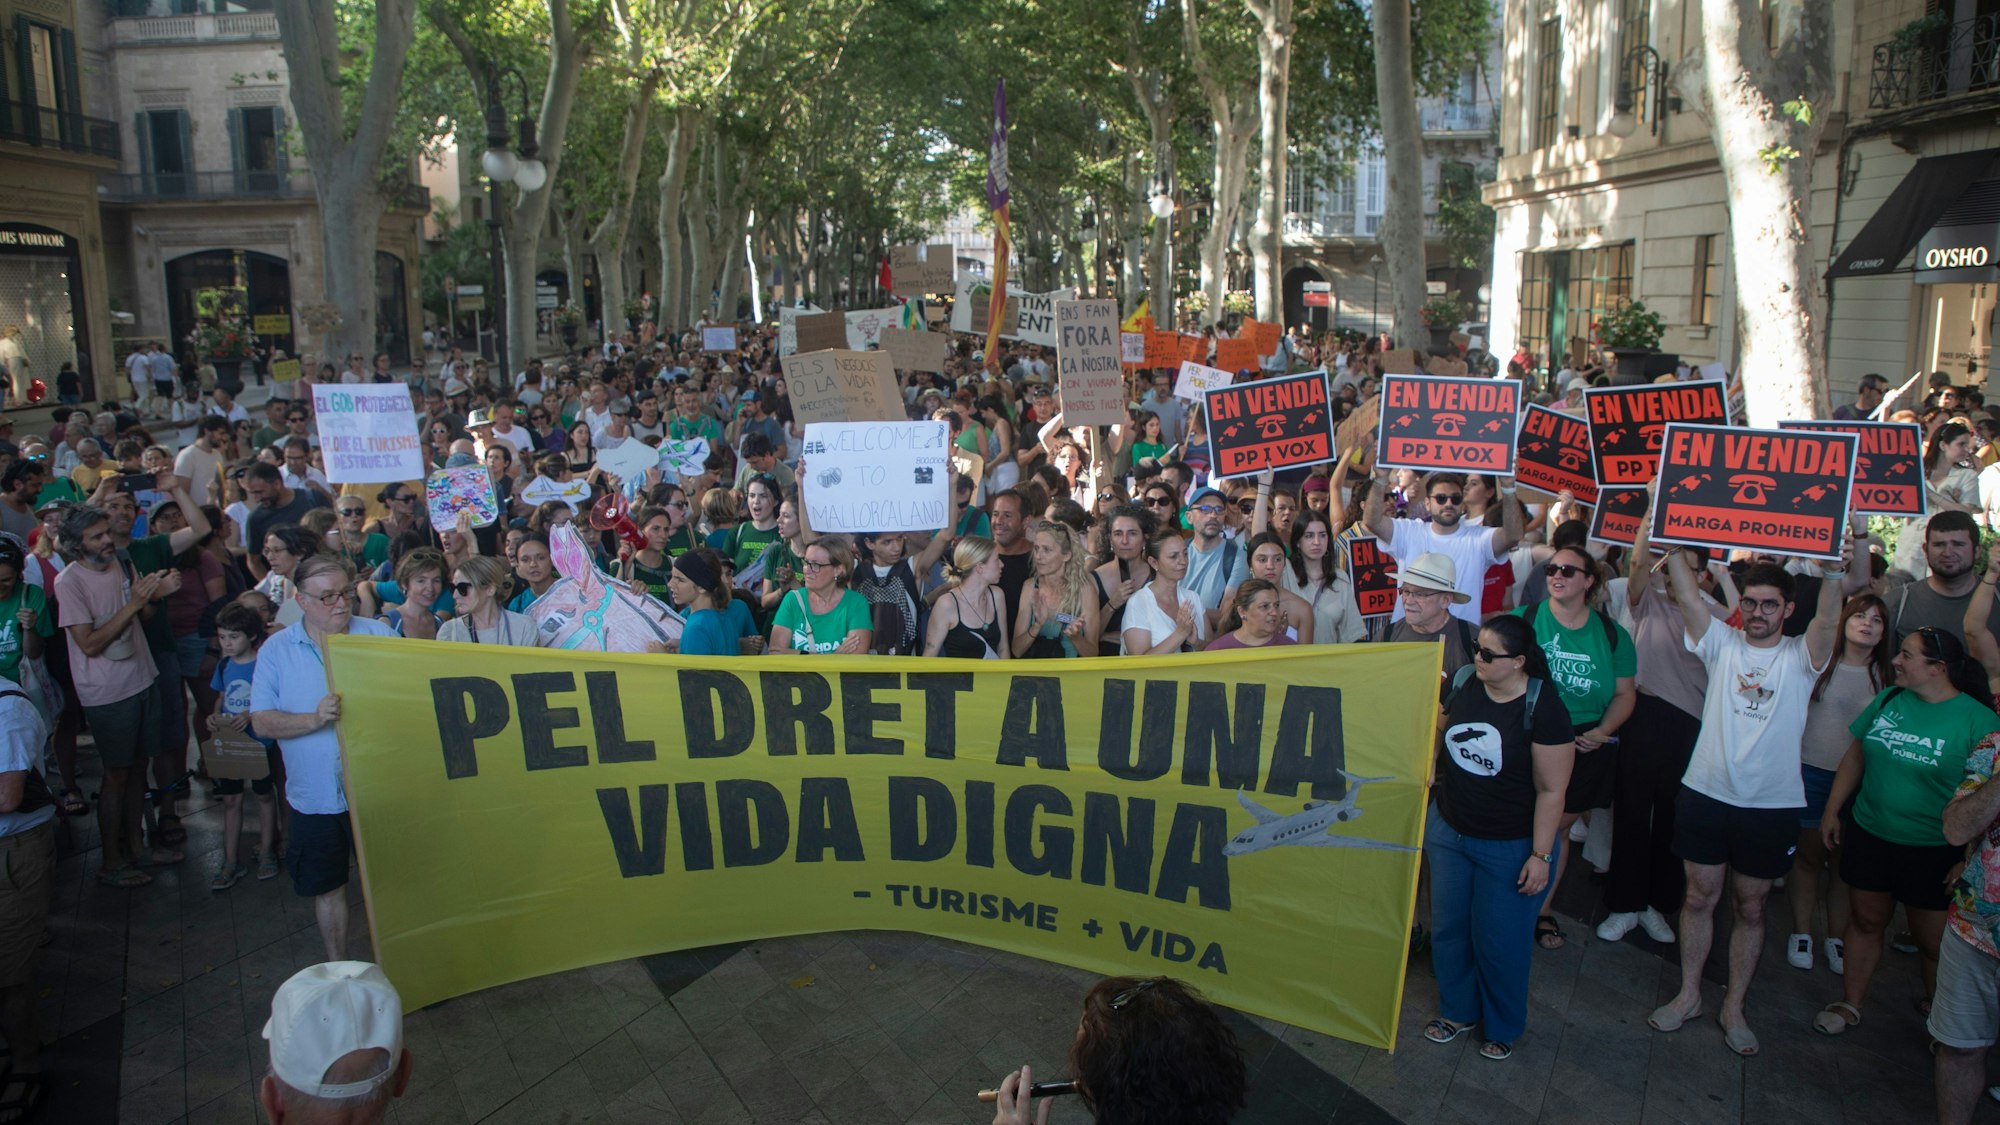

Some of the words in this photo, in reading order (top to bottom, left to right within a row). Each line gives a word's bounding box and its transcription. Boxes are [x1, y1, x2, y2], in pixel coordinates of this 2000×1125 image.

[1849, 258, 1885, 271] OYSHO
[1925, 246, 1989, 268] OYSHO
[1061, 306, 1079, 321] ENS
[1086, 304, 1110, 319] FAN
[1063, 325, 1112, 348] FORA
[788, 359, 824, 379] ELS
[834, 357, 878, 373] NEGOCIS
[1061, 358, 1078, 375] CA
[1082, 356, 1119, 373] NOSTRA
[1188, 365, 1202, 378] PER
[793, 380, 805, 397] O
[815, 376, 838, 393] LA
[1388, 381, 1420, 409] EN
[1427, 382, 1515, 413] VENDA
[315, 396, 330, 413] EL
[330, 391, 354, 414] GOB
[1065, 399, 1095, 412] NOSTRES
[1210, 391, 1241, 421] EN
[1244, 378, 1326, 415] VENDA
[1590, 394, 1624, 425] EN
[1625, 387, 1724, 423] VENDA
[1524, 409, 1558, 439] EN
[367, 433, 420, 453] TURISME
[820, 426, 926, 452] WELCOME
[1234, 450, 1258, 467] PP
[1263, 447, 1272, 462] I
[1277, 439, 1317, 460] VOX
[1401, 442, 1428, 459] PP
[1434, 444, 1443, 460] I
[1449, 445, 1494, 463] VOX
[1669, 430, 1715, 467] EN
[1723, 433, 1847, 478] VENDA
[854, 465, 886, 487] TO
[1616, 460, 1643, 477] PP
[1858, 487, 1905, 506] VOX
[812, 500, 945, 530] MALLORCALAND
[1667, 513, 1733, 533] MARGA
[1738, 518, 1830, 542] PROHENS
[1352, 541, 1374, 567] EN
[1369, 594, 1386, 608] PP
[1556, 658, 1591, 676] NO
[1567, 675, 1592, 689] TOCA
[228, 698, 250, 707] GOB
[432, 671, 656, 780] PEL
[676, 669, 974, 759] DRET
[997, 675, 1069, 771] A
[1096, 680, 1347, 800] UNA
[1460, 747, 1495, 770] GOB
[1892, 748, 1938, 767] PÚBLICA
[597, 777, 864, 880] VIDA
[890, 777, 1233, 912] DIGNA
[885, 885, 1058, 931] TURISME
[1119, 924, 1228, 976] VIDA
